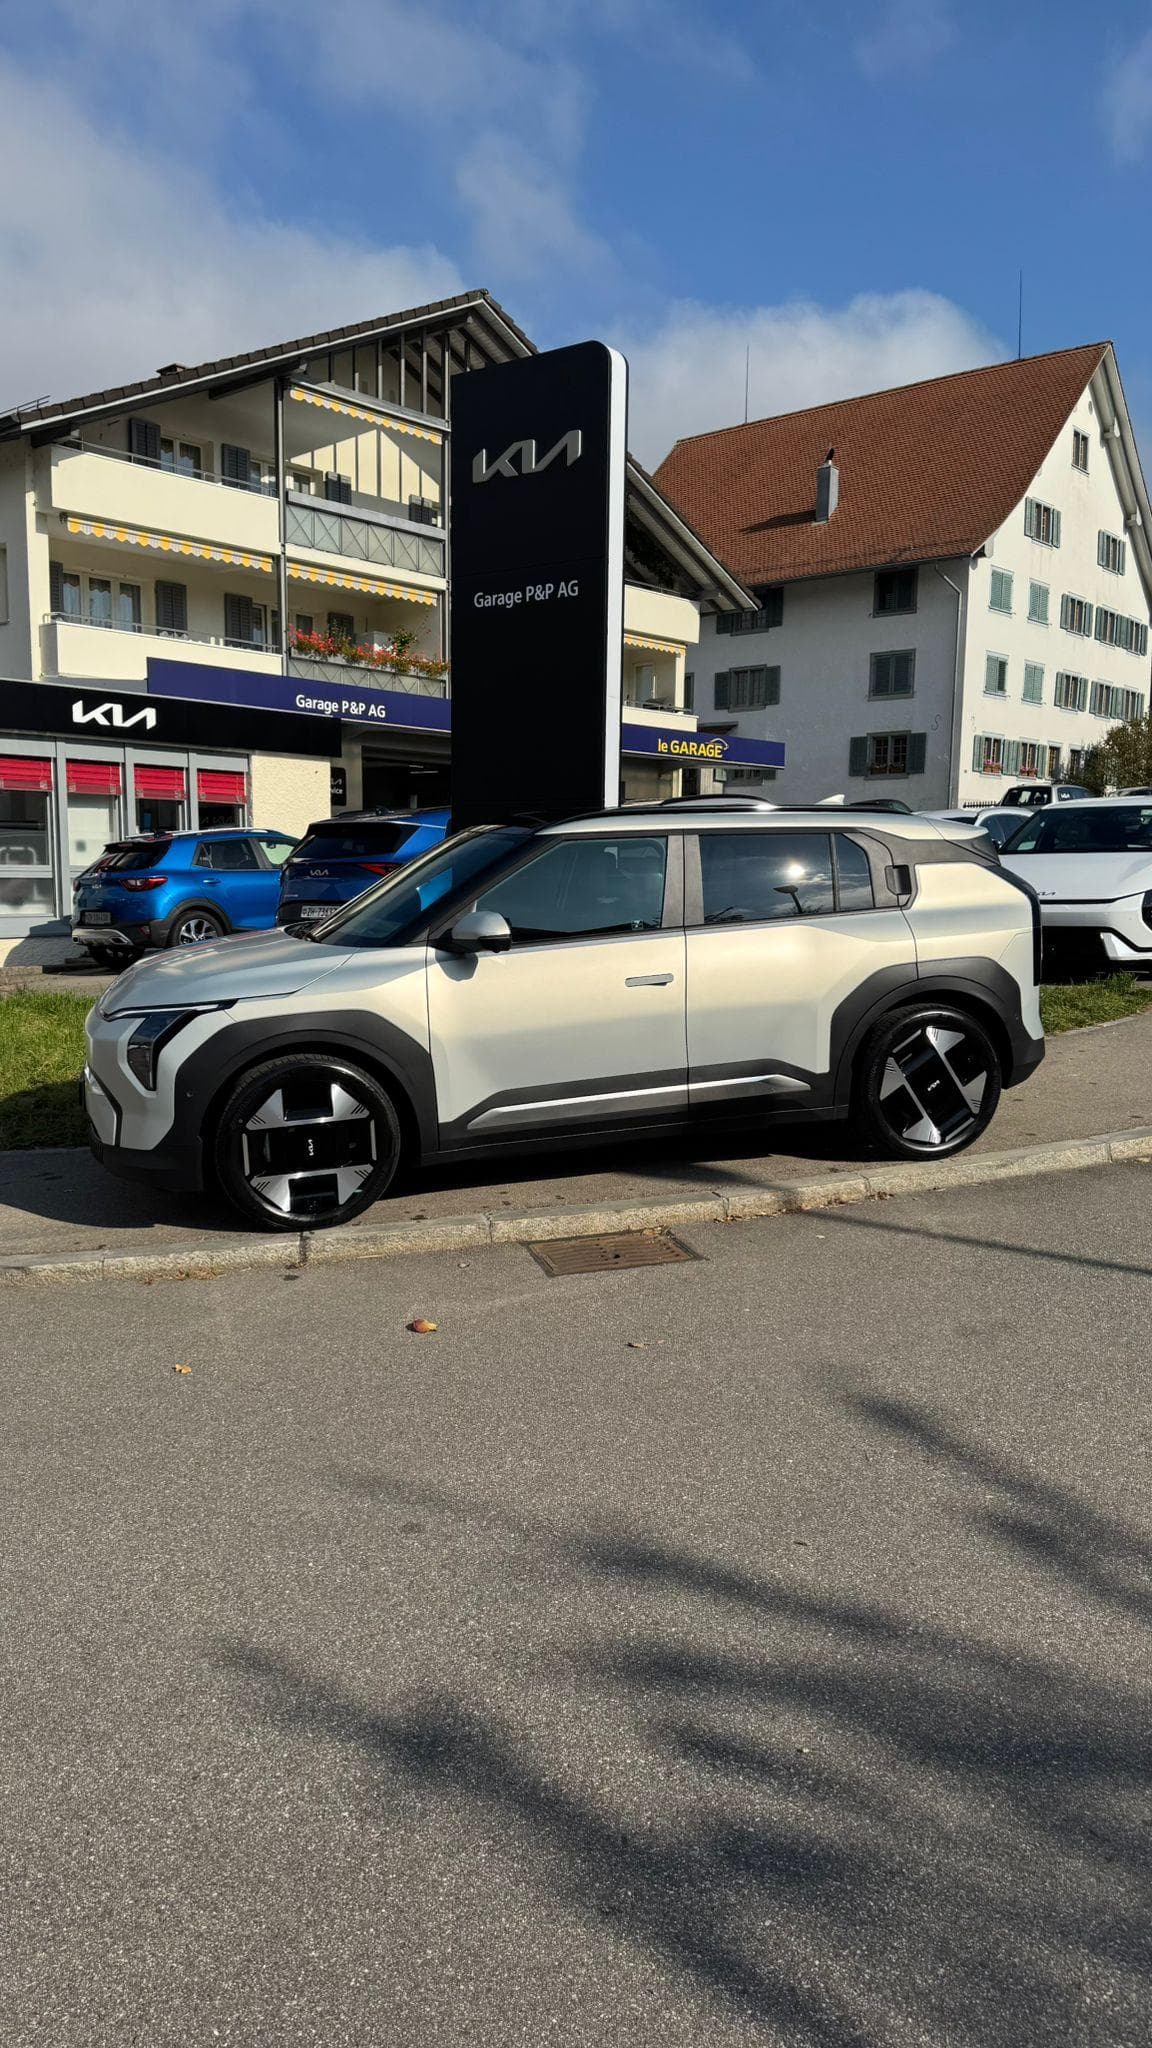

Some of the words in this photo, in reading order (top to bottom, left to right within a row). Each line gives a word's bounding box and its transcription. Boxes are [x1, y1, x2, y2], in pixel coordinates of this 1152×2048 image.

[472, 430, 582, 483] KIA
[474, 592, 522, 608] Garage
[526, 583, 554, 602] P&P
[558, 580, 579, 598] AG
[72, 700, 156, 730] KIA
[295, 694, 339, 714] Garage
[341, 700, 366, 715] P&P
[368, 703, 386, 718] AG
[658, 738, 668, 752] le
[670, 740, 723, 758] GARAGE
